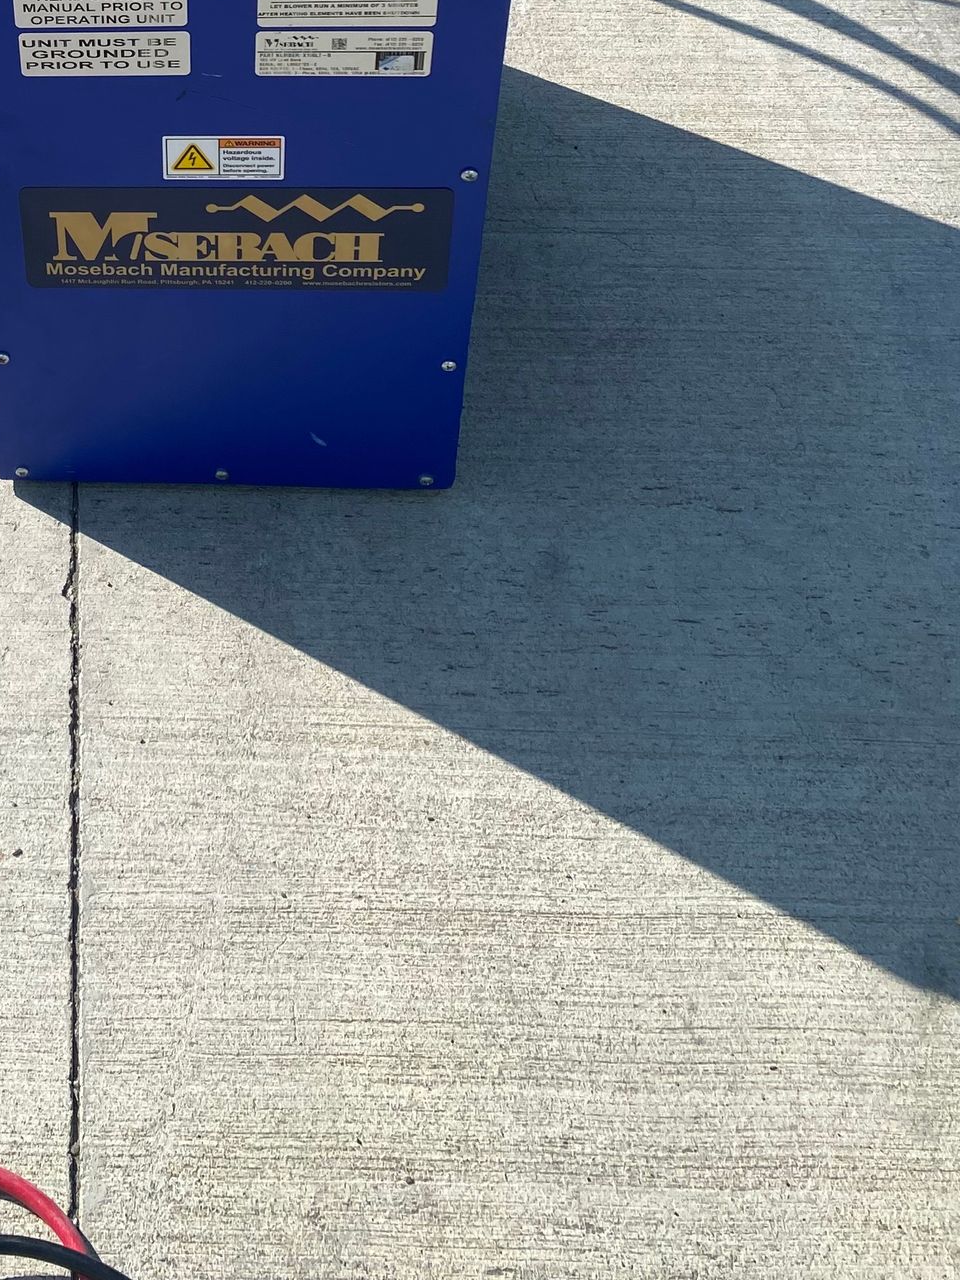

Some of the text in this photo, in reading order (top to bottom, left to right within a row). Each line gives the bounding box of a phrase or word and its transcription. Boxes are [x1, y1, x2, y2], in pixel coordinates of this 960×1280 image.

[23, 1, 183, 13] MANUAL PRIOR TO
[30, 14, 175, 25] OPERATING UNIT
[22, 37, 177, 48] UNIT MUST BE
[31, 48, 169, 59] GROUNDED
[25, 60, 181, 70] PRIOR TO USE
[46, 262, 426, 281] Mosebach Manufacturing Company
